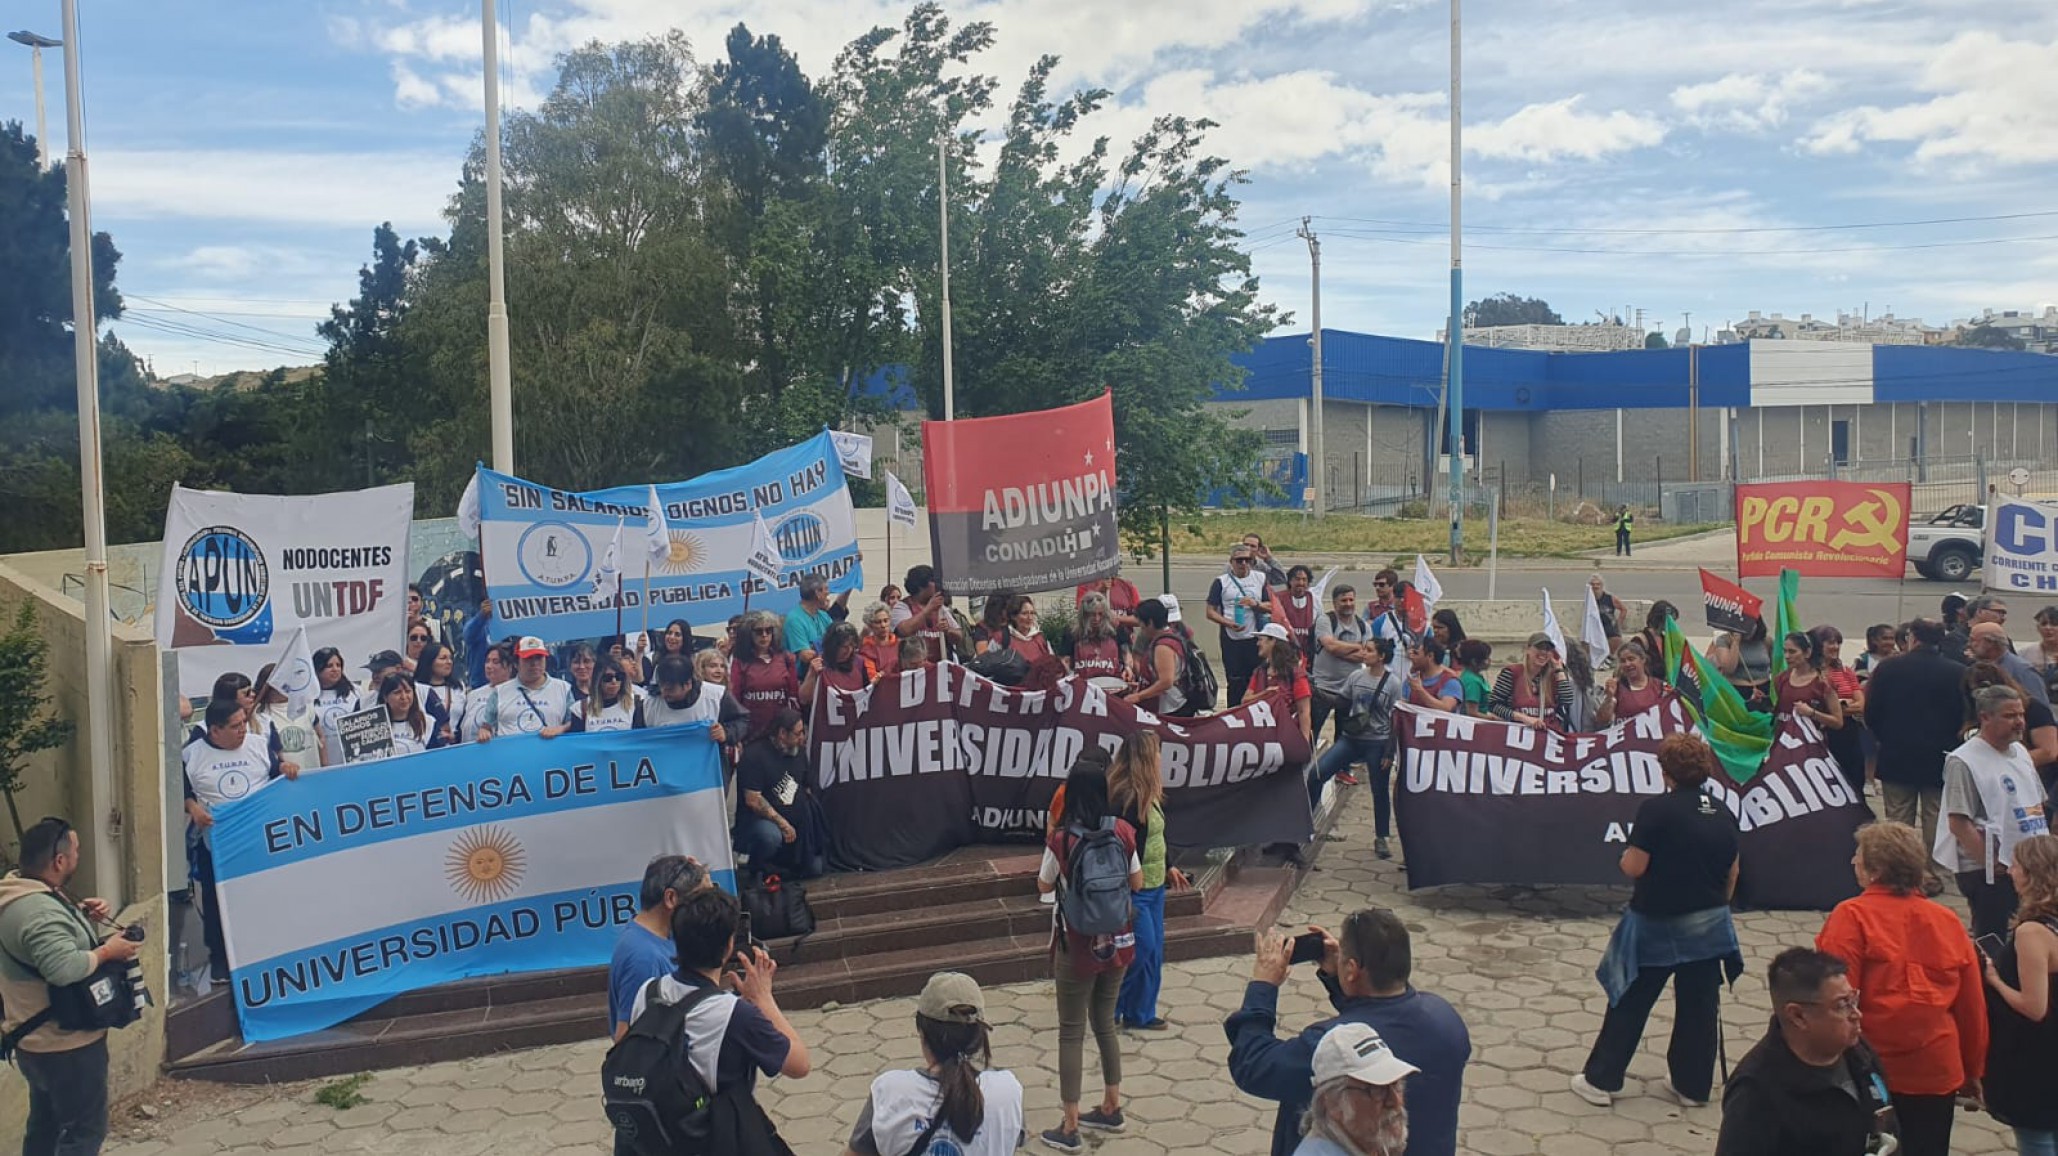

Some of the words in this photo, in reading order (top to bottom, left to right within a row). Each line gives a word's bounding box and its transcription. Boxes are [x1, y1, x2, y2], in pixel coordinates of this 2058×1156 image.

[790, 460, 825, 497] HAY
[982, 469, 1112, 531] ADIUNPA
[1741, 496, 1834, 544] PCR
[188, 536, 257, 615] APUN
[282, 546, 392, 570] NODOCENTES
[1991, 555, 2047, 571] CORRIENTE
[292, 578, 383, 618] UNTDF
[741, 578, 766, 594] DE
[1415, 712, 1475, 741] EN
[819, 719, 1084, 790] UNIVERSIDAD
[263, 811, 323, 854] EN
[335, 774, 532, 836] DEFENSA
[544, 765, 597, 799] DE
[609, 758, 658, 790] LA
[242, 908, 540, 1008] UNIVERSIDAD
[554, 889, 637, 934] PÚB
